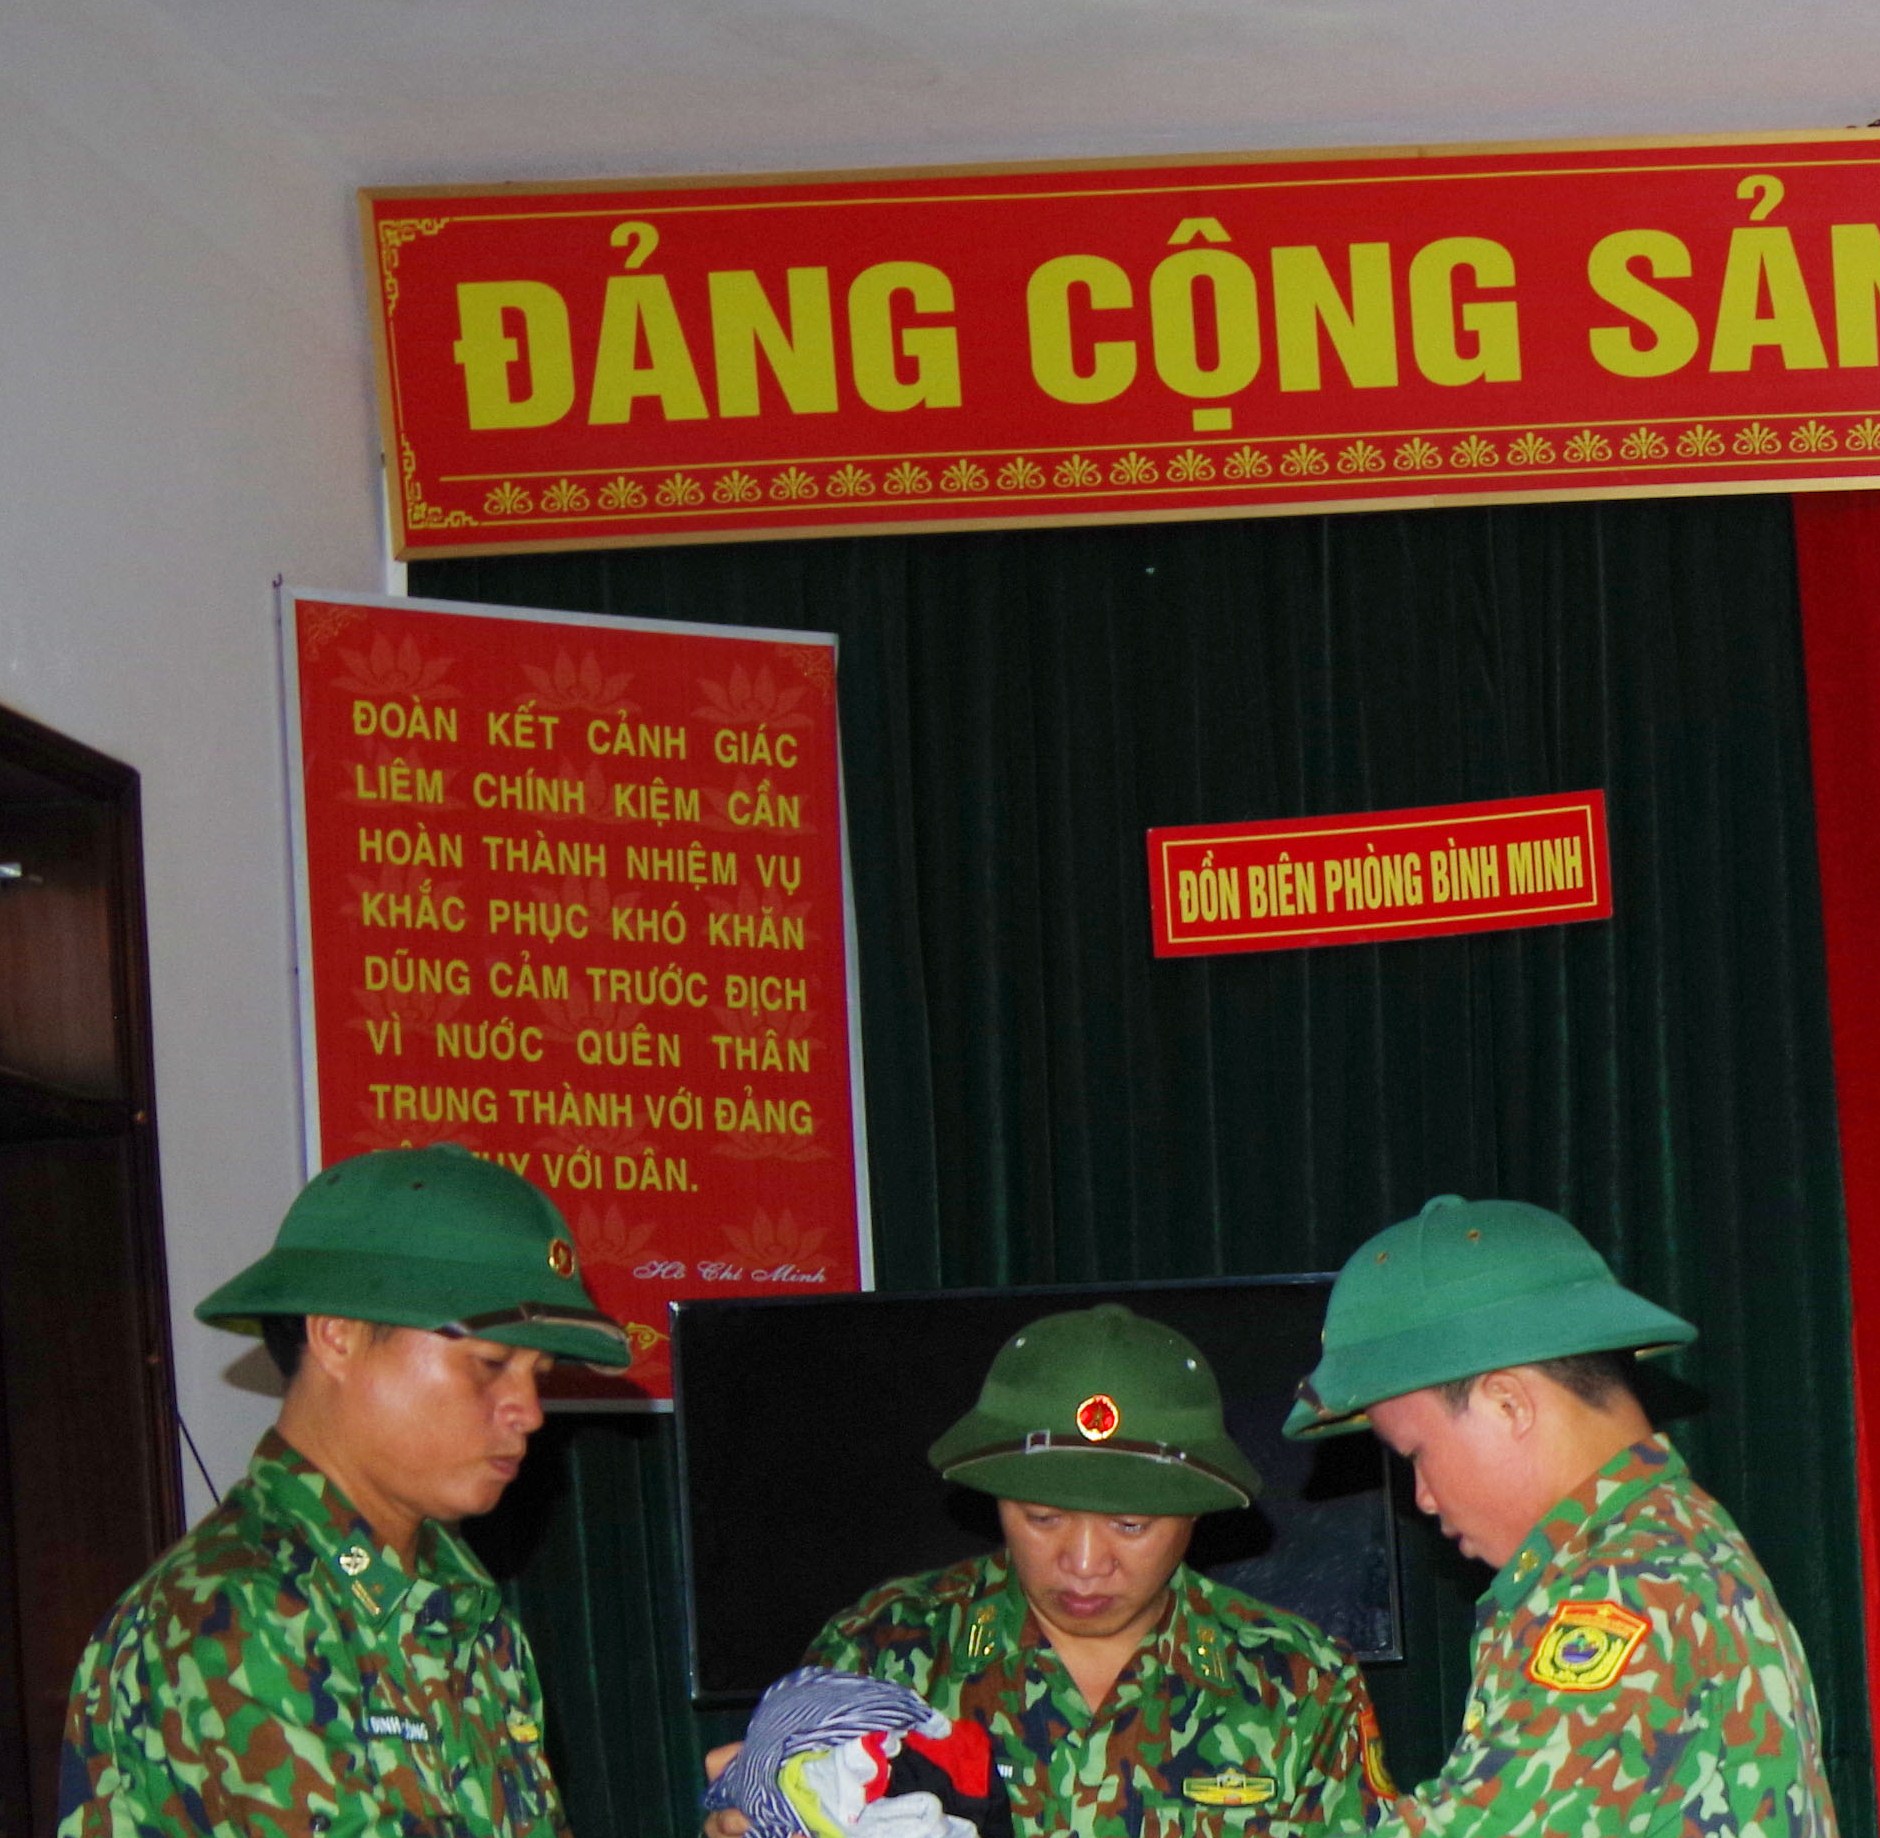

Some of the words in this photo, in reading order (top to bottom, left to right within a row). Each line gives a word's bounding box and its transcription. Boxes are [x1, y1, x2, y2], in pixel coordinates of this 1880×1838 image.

[453, 221, 962, 430] ĐẢNG
[1027, 217, 1522, 432] CỘNG
[353, 696, 457, 742] ĐOÀN
[488, 700, 559, 748] KẾT
[588, 709, 686, 759] CẢNH
[715, 724, 797, 768] GIÁC
[356, 757, 444, 804] LIÊM
[474, 768, 585, 814] CHÍNH
[614, 777, 700, 827] KIỆM
[728, 780, 800, 828] CẦN
[359, 823, 462, 867] HOÀN
[483, 832, 606, 877] THÀNH
[627, 841, 737, 890] NHIỆM
[756, 855, 800, 895] VỤ
[1179, 850, 1240, 923] ĐỒN
[1248, 852, 1317, 918] BIÊN
[1324, 844, 1423, 912] PHÒNG
[1430, 838, 1500, 903] BÌNH
[1507, 837, 1583, 895] MINH
[362, 879, 465, 932] KHẮC
[490, 900, 588, 943] PHỤC
[612, 902, 686, 944] KHÓ
[709, 907, 804, 950] KHĂN
[365, 949, 470, 996] DŨNG
[490, 951, 569, 999] CẢM
[586, 964, 707, 1007] TRƯỚC
[725, 975, 806, 1016] ĐỊCH
[366, 1012, 401, 1055] VÌ
[436, 1018, 543, 1062] NƯỚC
[577, 1024, 680, 1067] QUÊN
[711, 1029, 809, 1072] THÂN
[369, 1084, 497, 1123] TRUNG
[509, 1083, 633, 1127] THÀNH
[645, 1088, 703, 1130] VỚI
[715, 1086, 813, 1135] ĐẢNG
[543, 1146, 602, 1189] VỚI
[615, 1147, 697, 1191] DÂN.
[751, 1263, 826, 1283] Minh
